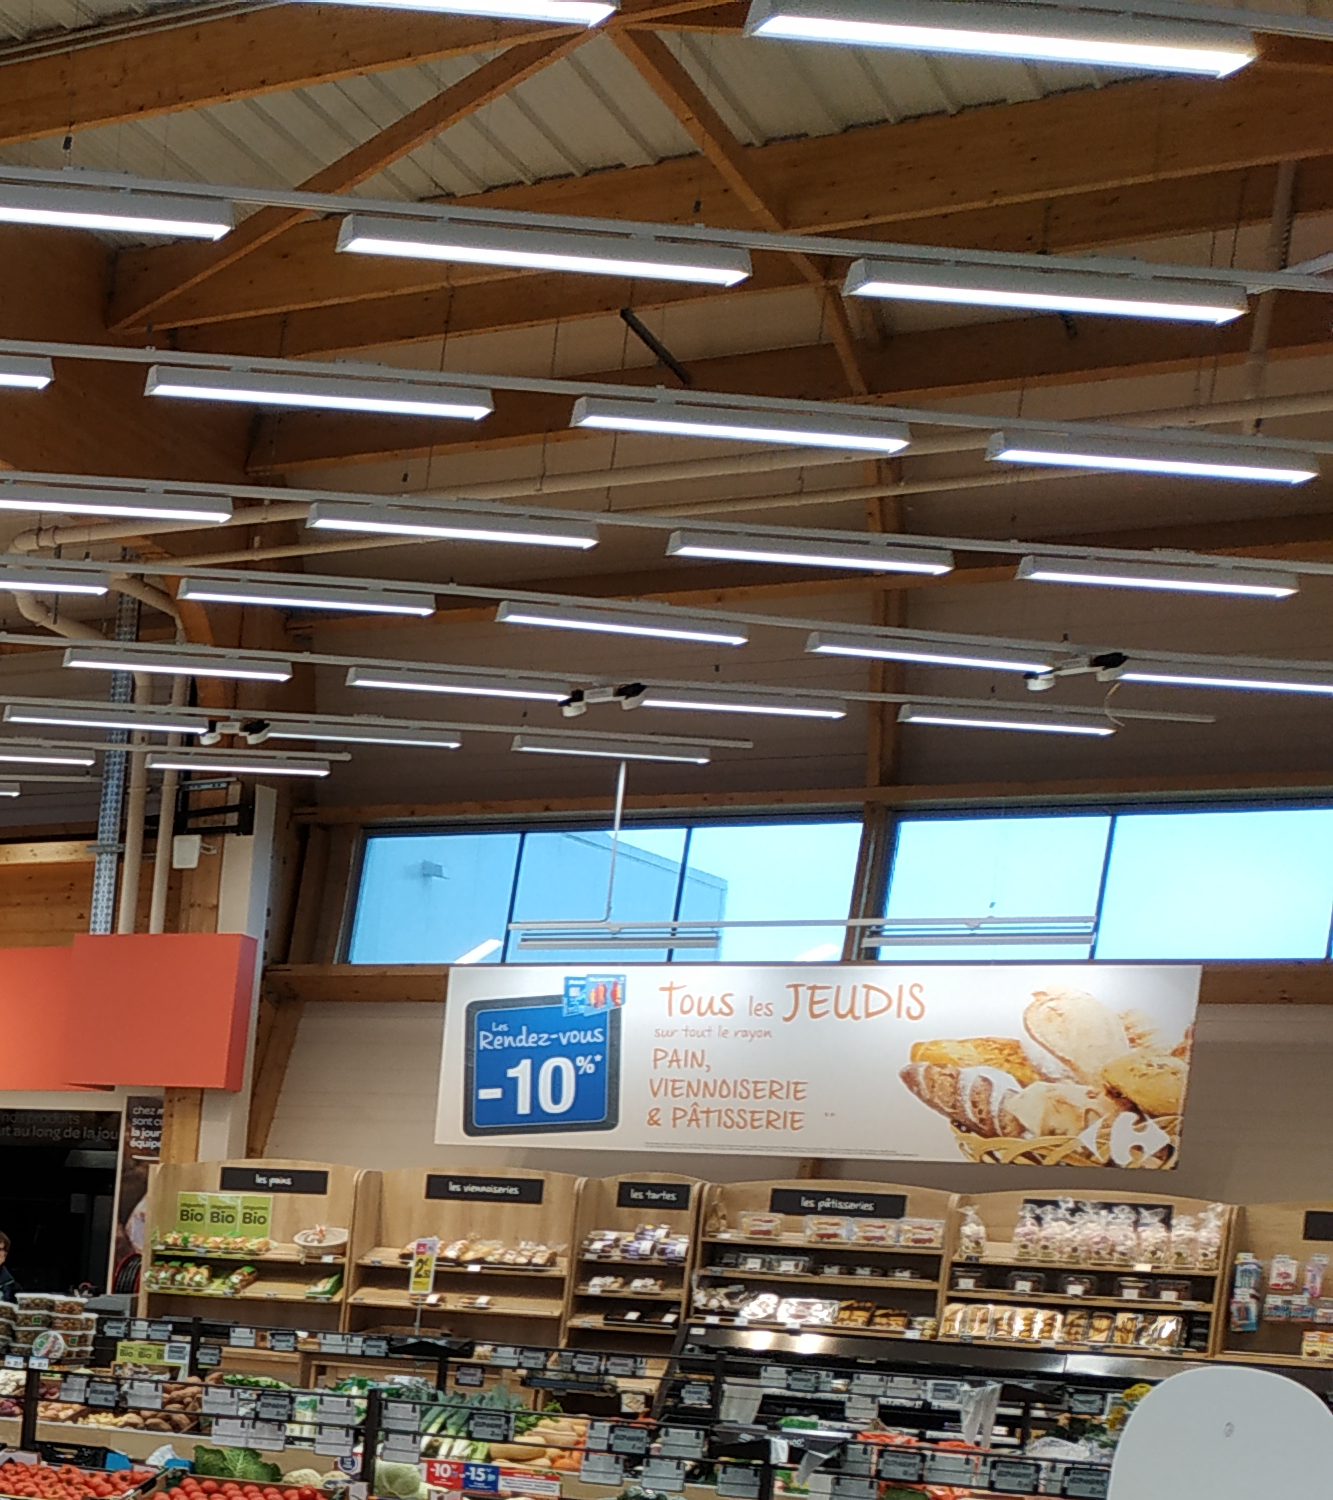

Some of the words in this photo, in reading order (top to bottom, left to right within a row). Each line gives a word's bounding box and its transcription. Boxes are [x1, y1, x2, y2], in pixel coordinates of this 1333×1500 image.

[659, 981, 734, 1017] Tous
[749, 996, 773, 1017] les
[783, 983, 925, 1022] JEUDIS
[492, 1022, 508, 1031] Les
[479, 1026, 604, 1050] Rendez-vous
[654, 1028, 677, 1038] sur
[682, 1026, 712, 1037] tout
[718, 1026, 729, 1038] le
[734, 1029, 772, 1042] rayon
[653, 1048, 711, 1072] PAIN,
[649, 1078, 808, 1101] VIENNOISERIE
[133, 1106, 155, 1114] chez
[647, 1108, 661, 1127] &
[672, 1102, 805, 1130] PÂTISSERIE
[133, 1117, 152, 1125] sont
[448, 1181, 461, 1192] les
[465, 1183, 519, 1195] viennoiseries
[630, 1188, 644, 1200] les
[647, 1189, 677, 1202] tartes
[801, 1196, 814, 1208] les
[180, 1209, 204, 1222] Bio
[211, 1211, 234, 1224] Bio
[242, 1212, 267, 1225] Bio
